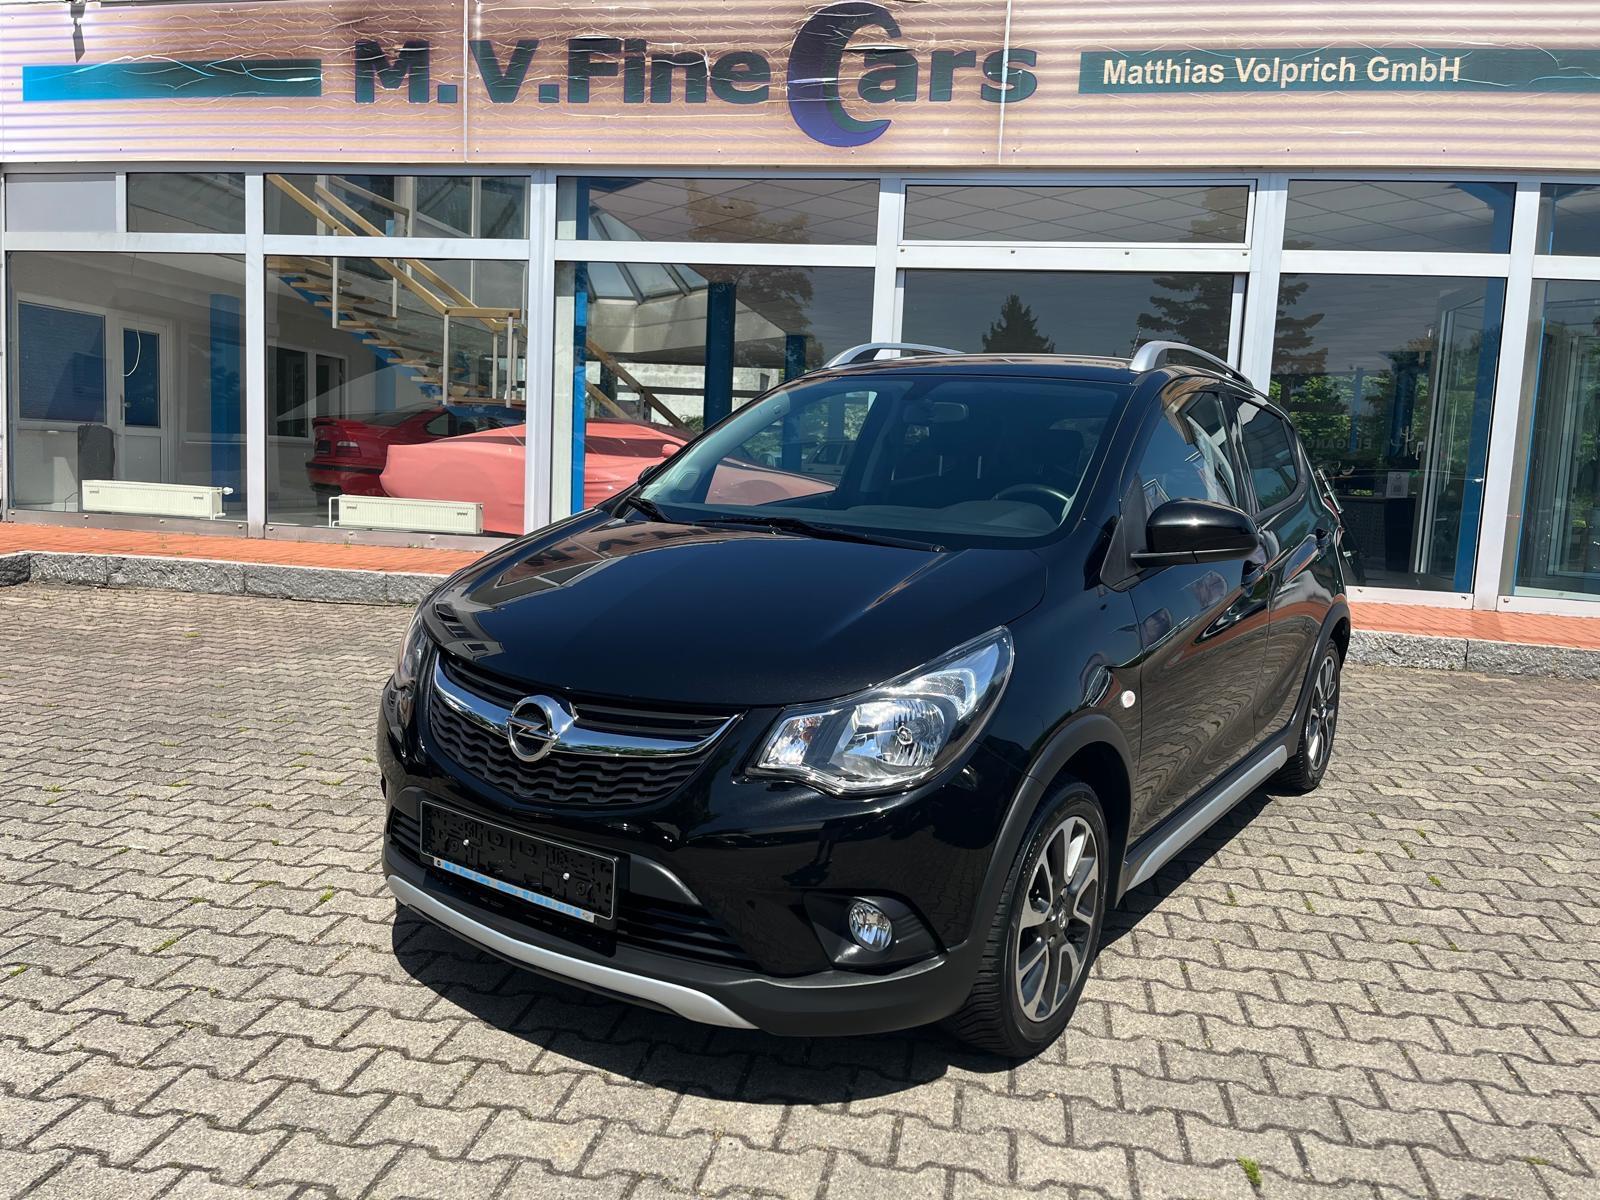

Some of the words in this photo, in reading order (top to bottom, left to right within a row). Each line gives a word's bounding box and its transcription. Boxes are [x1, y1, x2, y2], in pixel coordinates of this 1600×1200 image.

[1103, 58, 1224, 85] Matthias
[1235, 56, 1356, 88] Volprich
[1366, 56, 1461, 83] GmbH
